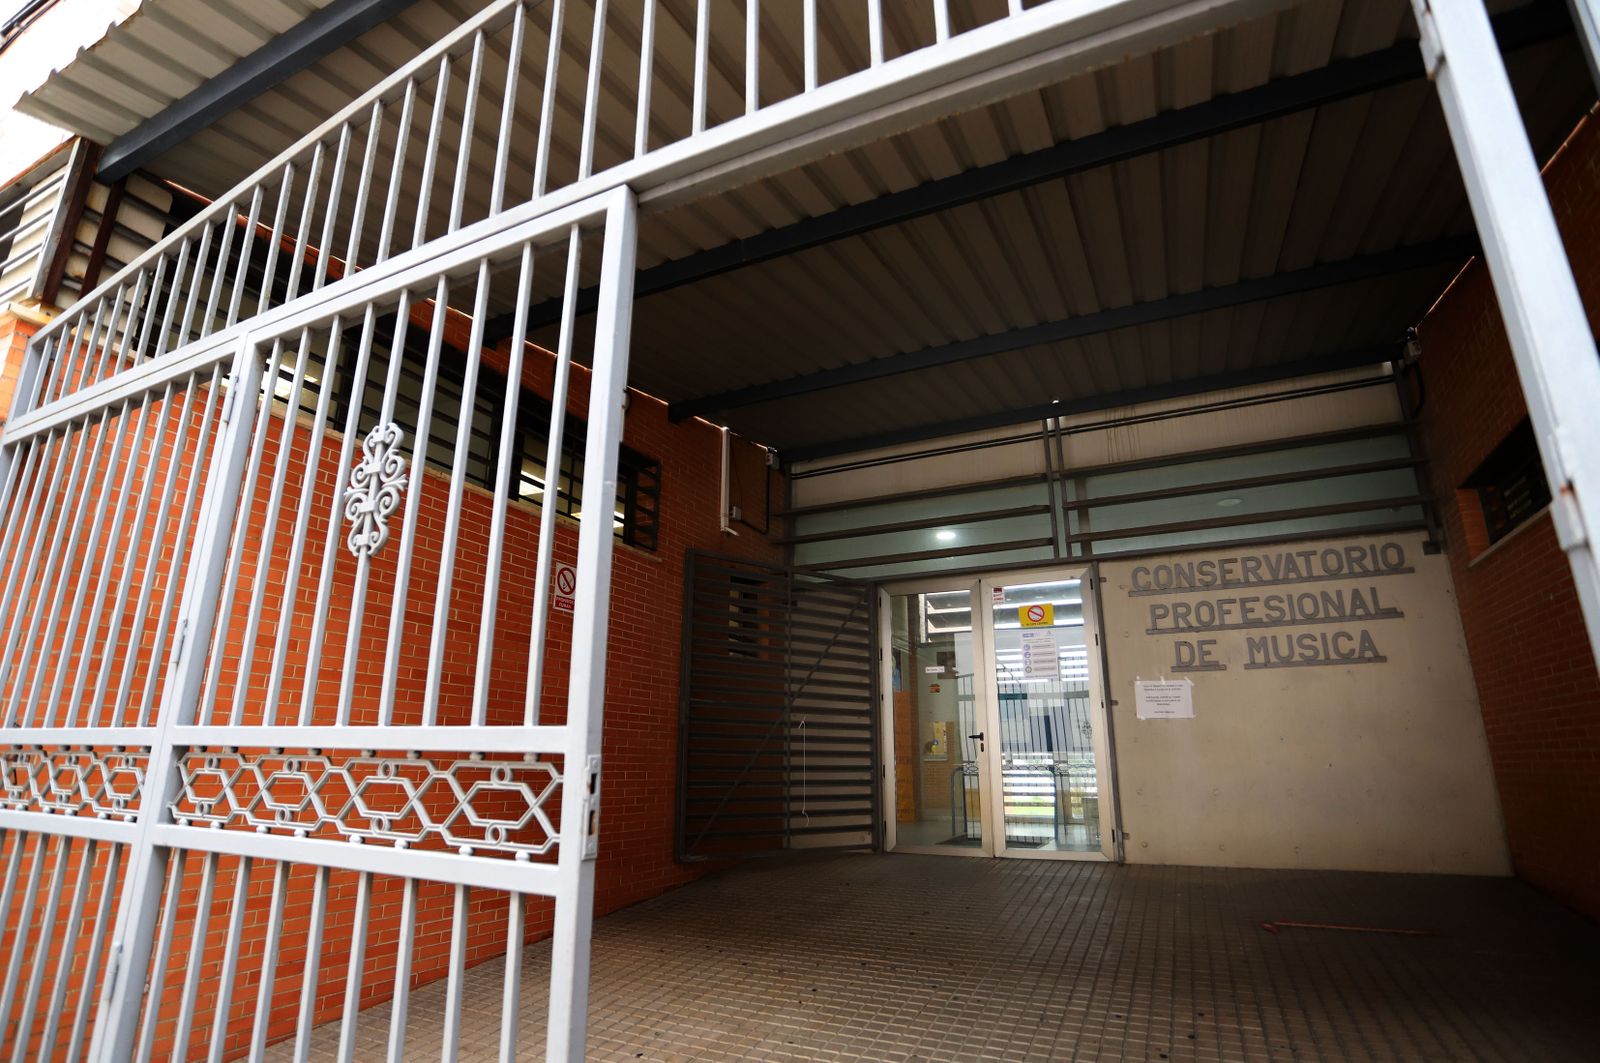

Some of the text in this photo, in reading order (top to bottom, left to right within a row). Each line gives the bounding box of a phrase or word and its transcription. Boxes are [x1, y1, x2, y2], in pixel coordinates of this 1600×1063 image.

[1131, 543, 1405, 591] CONSERVATORIO
[1150, 587, 1398, 629] PROFESIONAL
[1174, 629, 1380, 667] DE MUSICA
